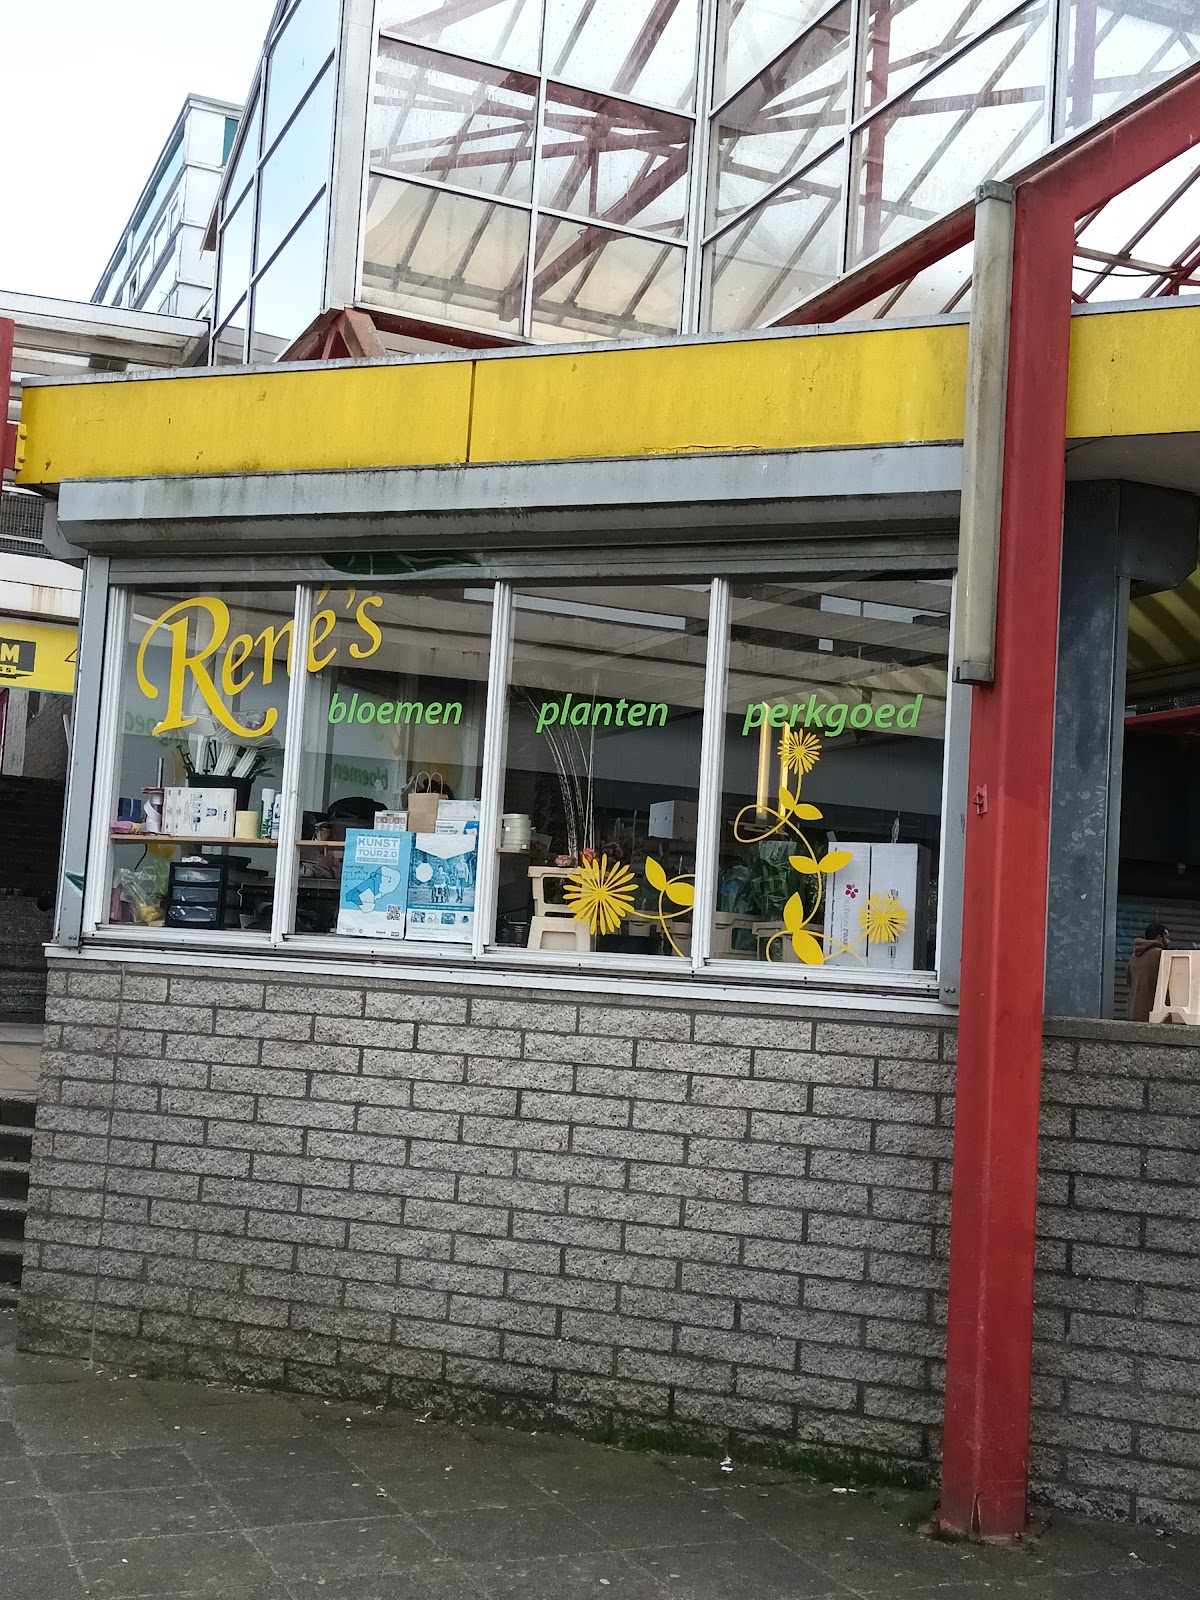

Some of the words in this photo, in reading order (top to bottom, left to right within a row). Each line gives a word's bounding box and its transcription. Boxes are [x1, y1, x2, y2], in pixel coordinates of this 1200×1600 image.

[137, 583, 383, 737] René's
[328, 693, 463, 725] bloemen
[536, 694, 668, 733] planten
[742, 694, 923, 737] perkgoed
[358, 838, 398, 847] KUNST
